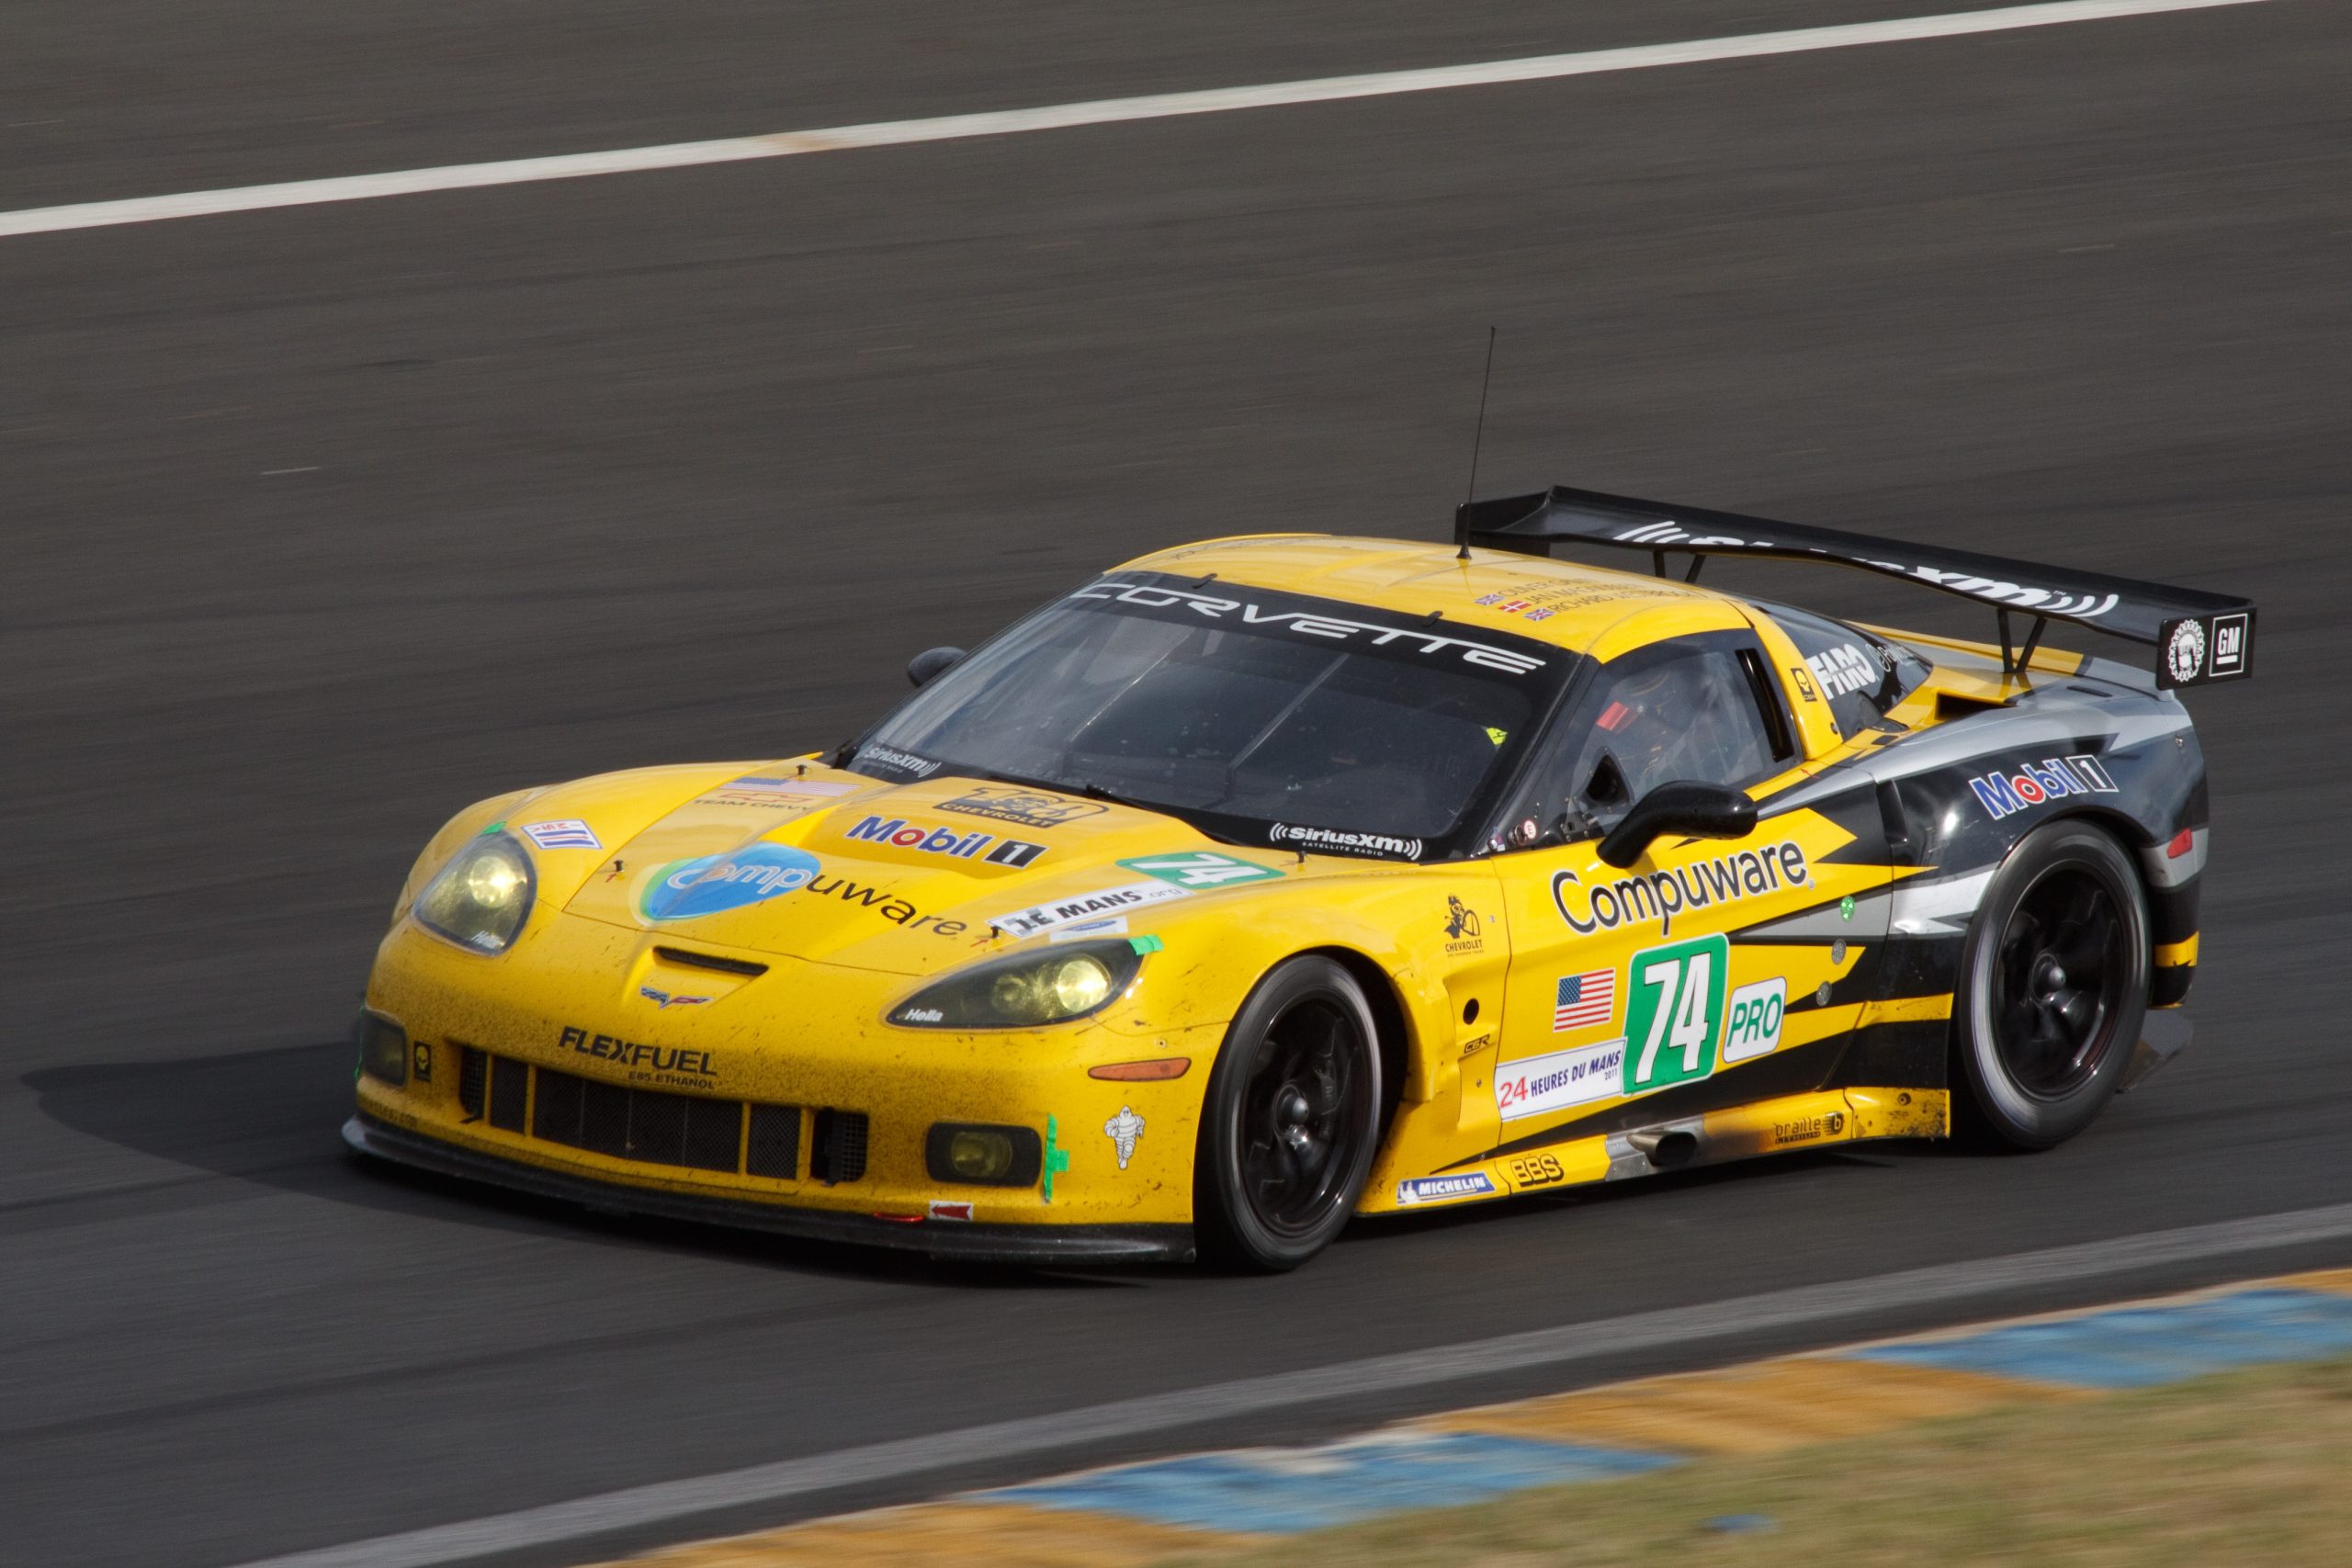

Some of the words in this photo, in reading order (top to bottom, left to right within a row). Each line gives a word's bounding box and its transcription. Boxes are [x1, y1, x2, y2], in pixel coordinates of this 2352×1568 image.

[1070, 582, 1545, 674] CORVETTE
[2218, 626, 2240, 655] GM
[1805, 644, 1876, 700] FARO
[1968, 758, 2088, 820] Mobil
[942, 803, 1054, 827] CHEVROLET
[846, 815, 994, 859] Mobil
[1302, 841, 1351, 852] SATELLITE
[1354, 848, 1384, 857] RADIO
[1056, 890, 1143, 919] MANS
[1552, 841, 1807, 938] Compuware
[1445, 939, 1483, 953] CHEVROLET
[904, 1009, 944, 1021] Hella
[1634, 951, 1712, 1085] 74
[1726, 993, 1782, 1048] PRO
[558, 1026, 718, 1076] FLEXFUEL
[628, 1071, 652, 1082] E85
[655, 1073, 715, 1089] ETHANOL
[1499, 1076, 1529, 1109] 24
[1531, 1068, 1569, 1097] HEURES
[1572, 1062, 1587, 1082] DU
[1589, 1050, 1622, 1076] MANS
[1604, 1070, 1618, 1081] 2011
[1419, 1177, 1487, 1195] MICHELIN
[1510, 1154, 1565, 1188] BBS
